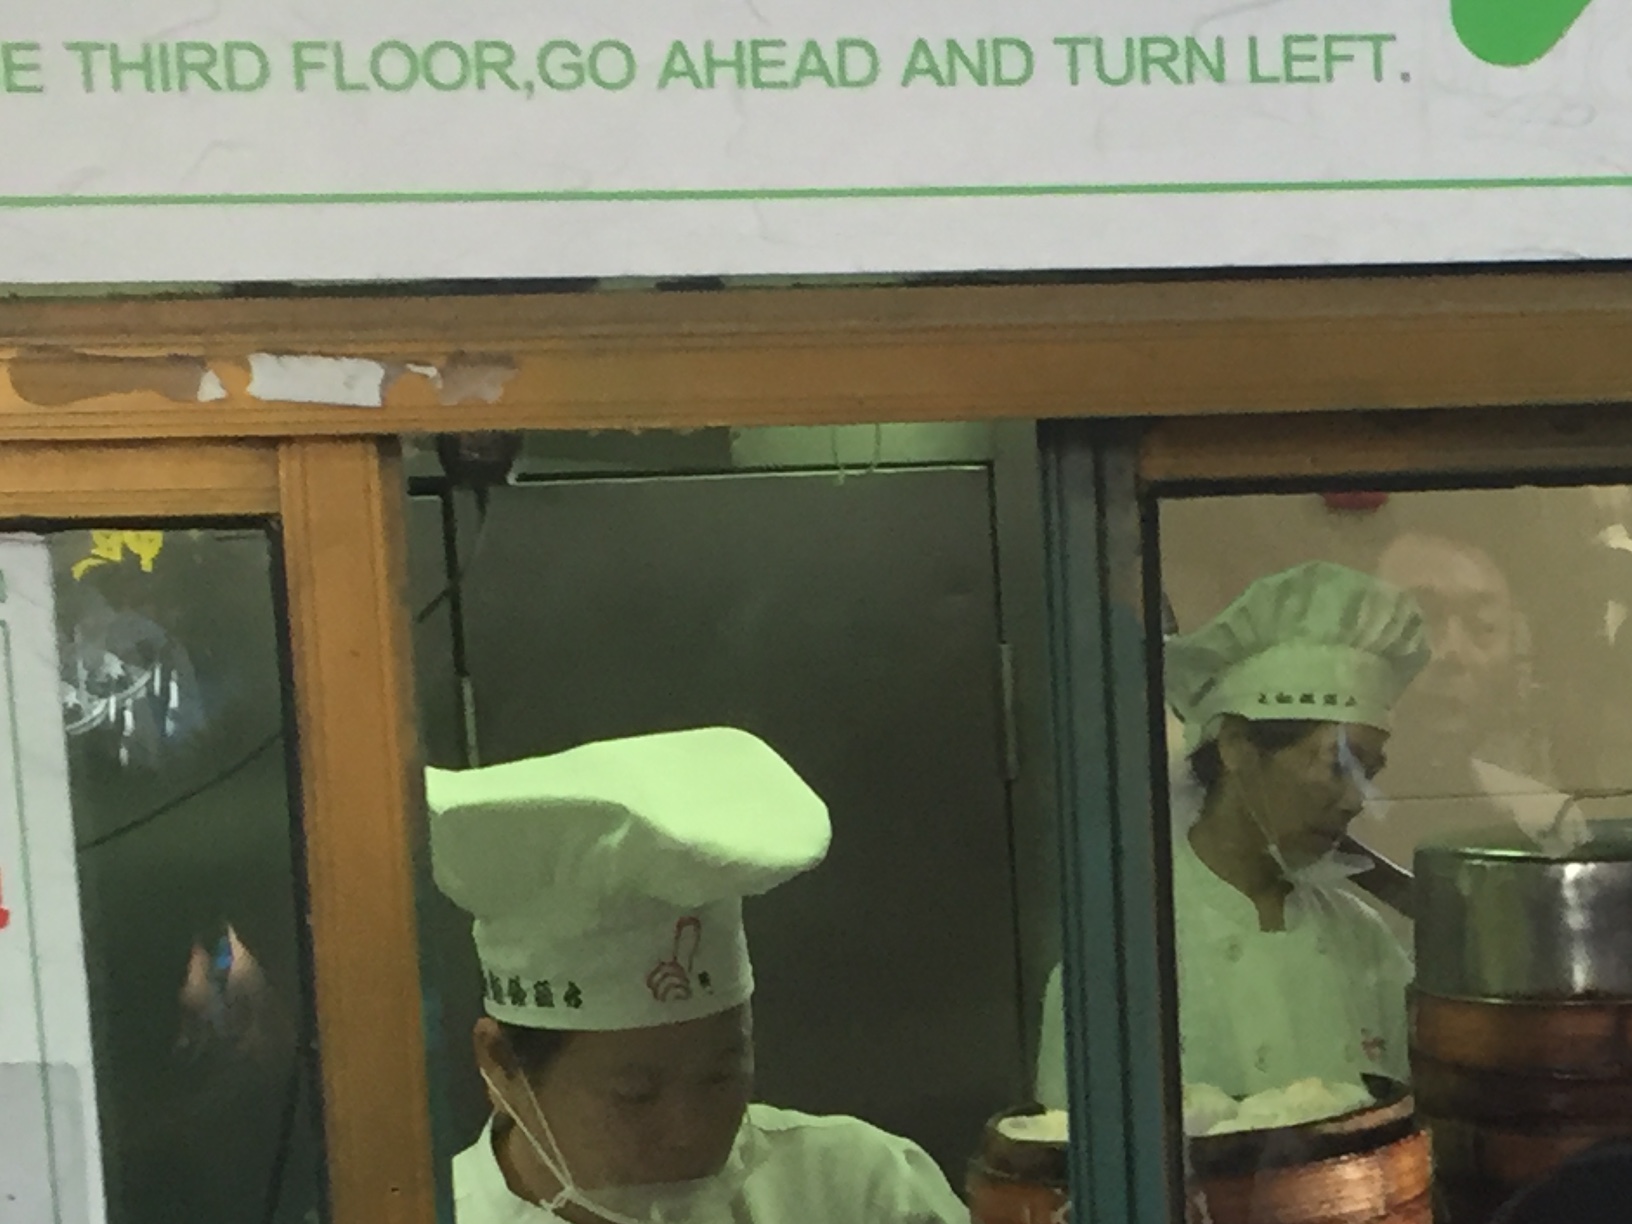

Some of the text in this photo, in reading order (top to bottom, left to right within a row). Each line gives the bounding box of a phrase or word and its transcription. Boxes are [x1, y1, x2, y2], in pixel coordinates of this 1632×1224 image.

[65, 40, 271, 93] THIRD
[658, 37, 881, 91] AHEAD
[900, 36, 1034, 88] AND
[1053, 34, 1226, 86] TURN
[1248, 33, 1412, 83] LEFT.
